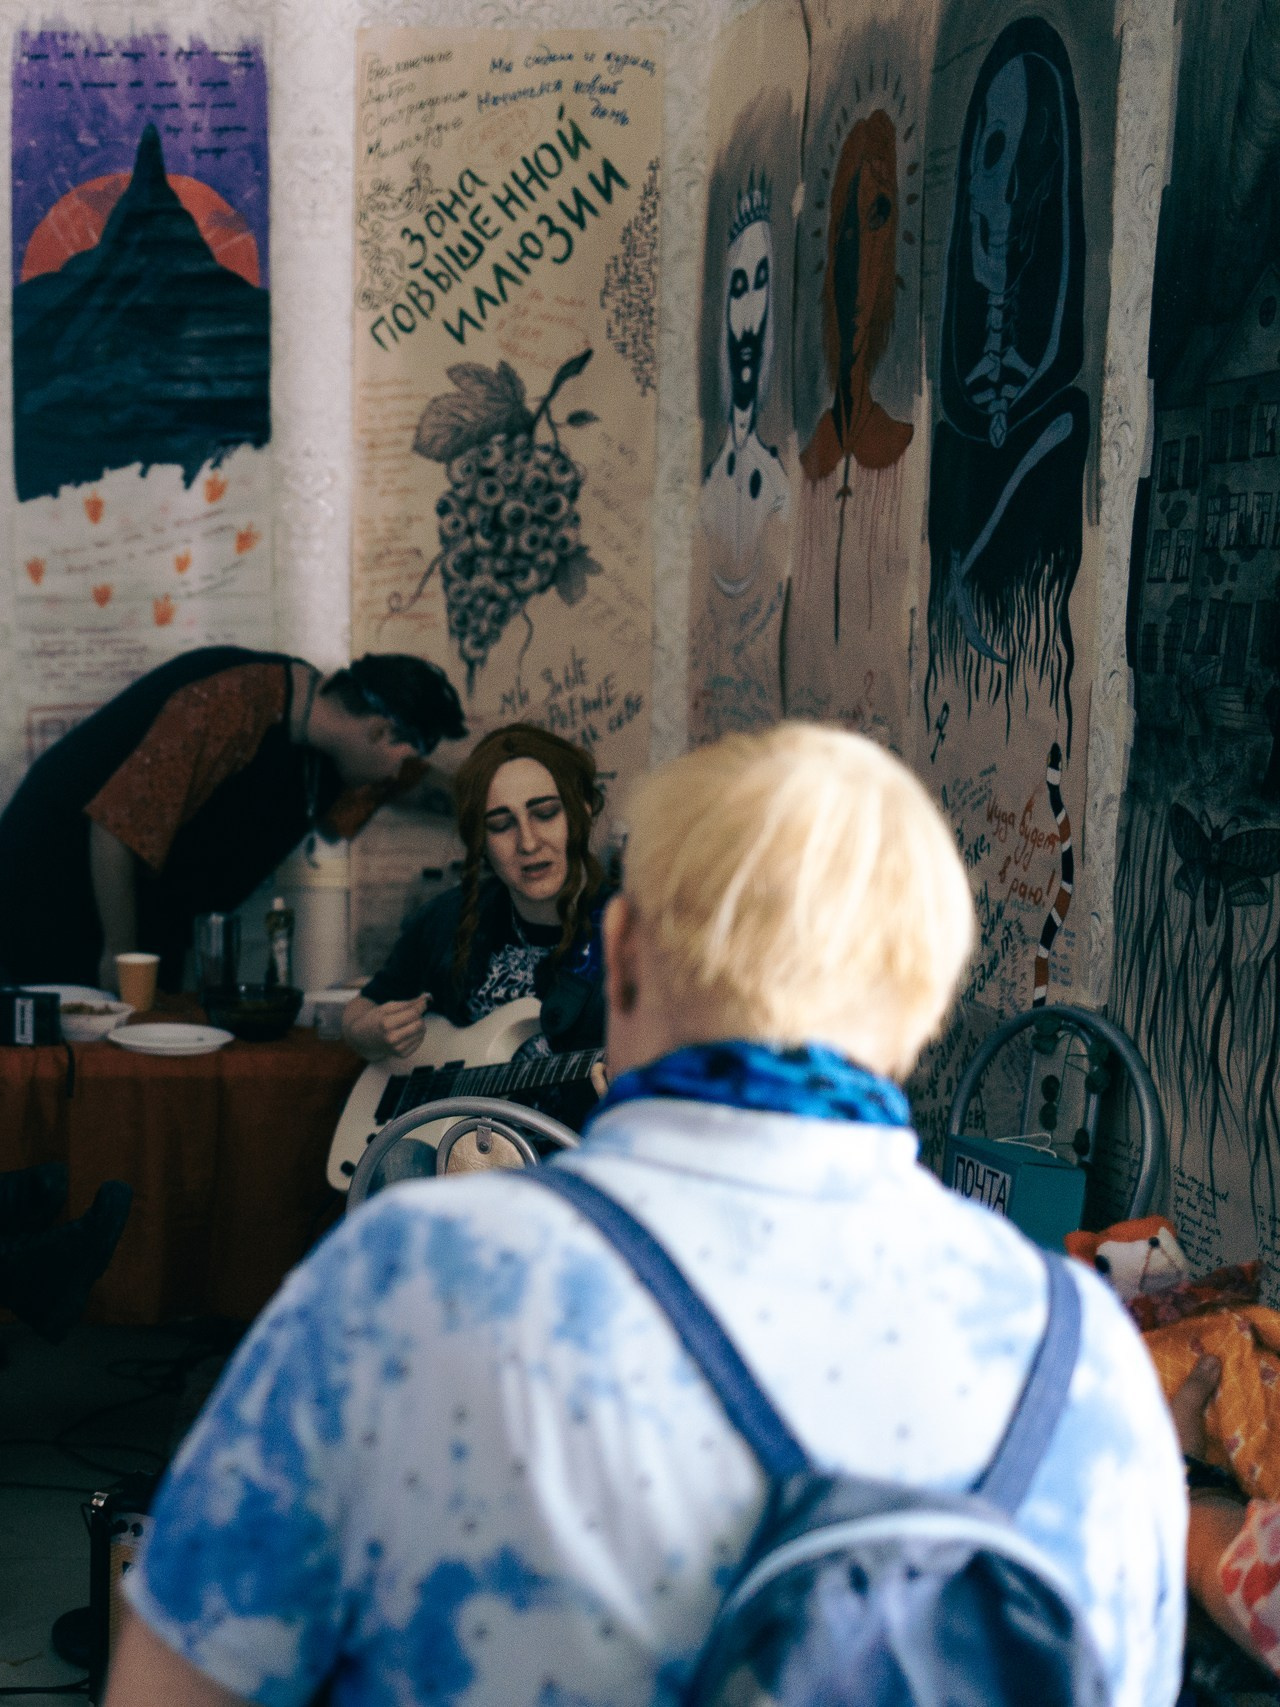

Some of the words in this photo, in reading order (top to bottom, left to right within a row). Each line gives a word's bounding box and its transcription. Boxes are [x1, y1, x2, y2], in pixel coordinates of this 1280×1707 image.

[370, 102, 592, 352] ПОВЫШЕННОЙ
[442, 157, 630, 345] ИЛЛЮЗИИ
[953, 1155, 1008, 1217] ПОЧТА
